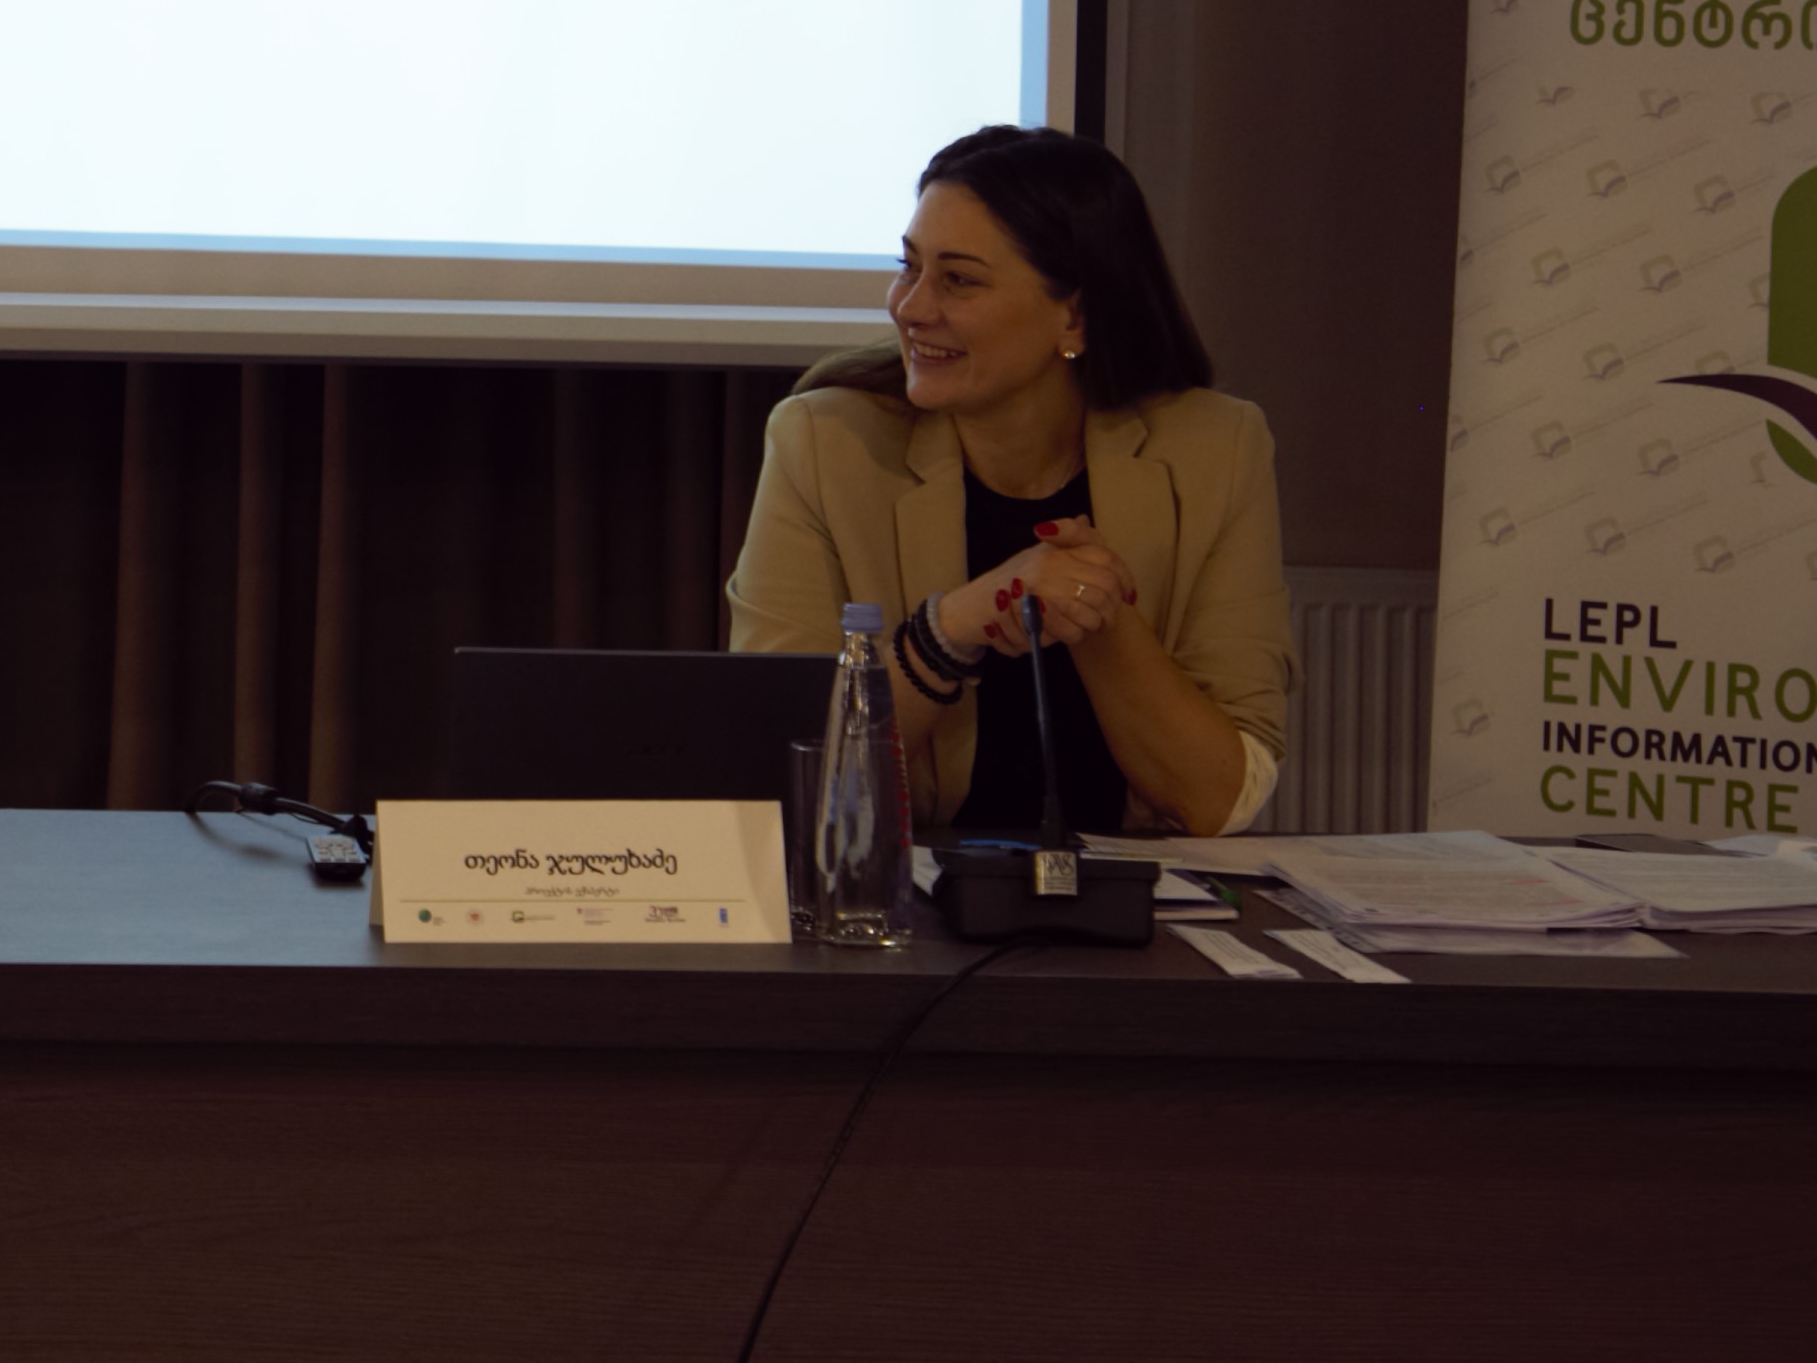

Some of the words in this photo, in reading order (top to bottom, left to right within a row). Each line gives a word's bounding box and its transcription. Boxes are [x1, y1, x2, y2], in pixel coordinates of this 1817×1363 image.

[1544, 597, 1678, 649] LEPL
[1543, 648, 1817, 724] ENVIRO
[1540, 764, 1799, 835] CENTRE
[464, 848, 540, 876] თეონა
